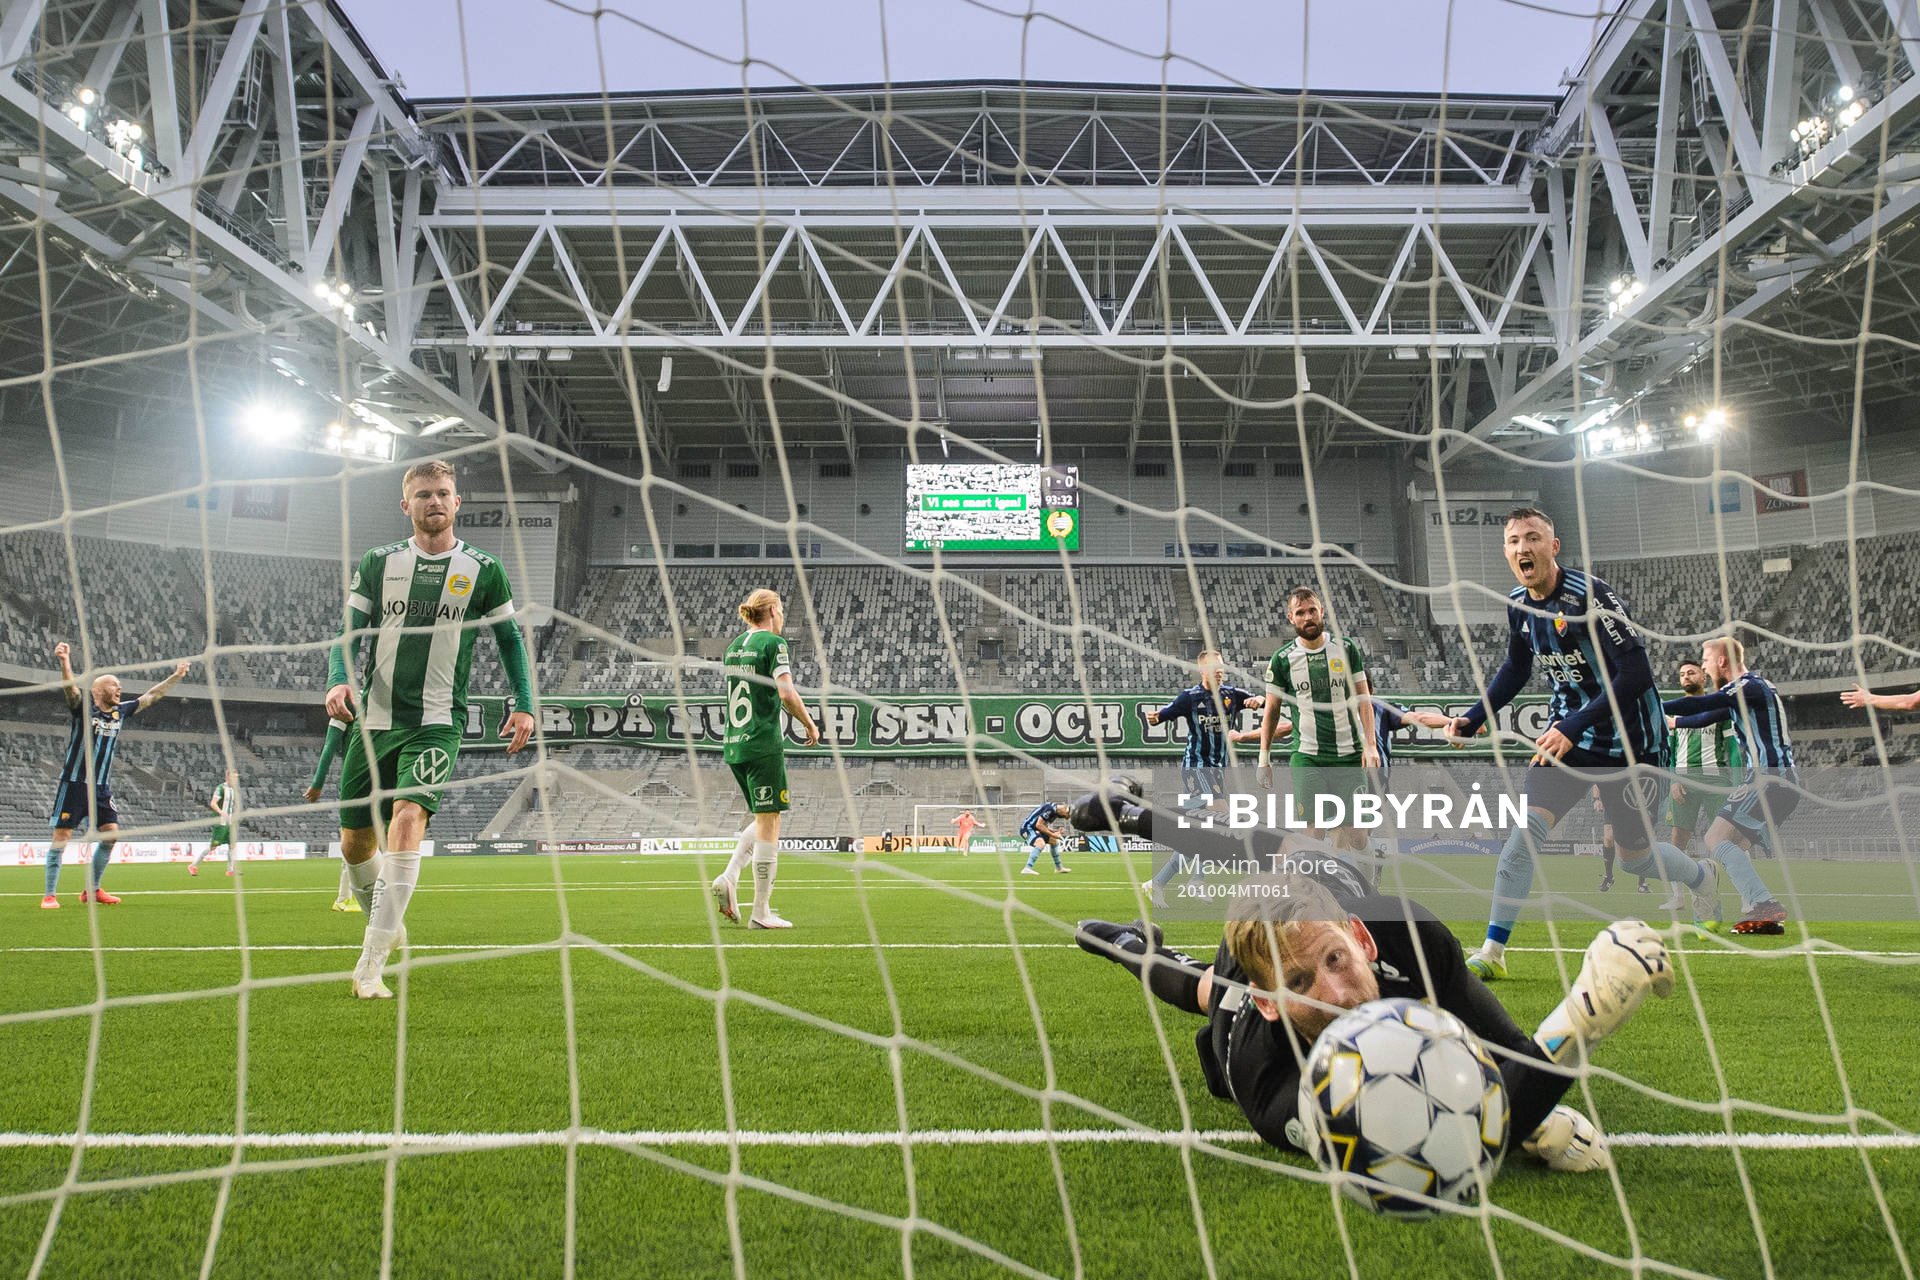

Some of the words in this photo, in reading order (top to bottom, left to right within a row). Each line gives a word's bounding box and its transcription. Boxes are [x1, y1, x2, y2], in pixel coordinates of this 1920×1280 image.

[1065, 476, 1073, 487] 0
[1045, 495, 1073, 506] 93:32
[383, 600, 466, 623] JOBMAN
[1296, 679, 1345, 691] JOAN
[586, 694, 654, 739] DÅ
[781, 704, 859, 744] CH
[871, 703, 969, 744] SEN
[1015, 703, 1124, 744] OCH
